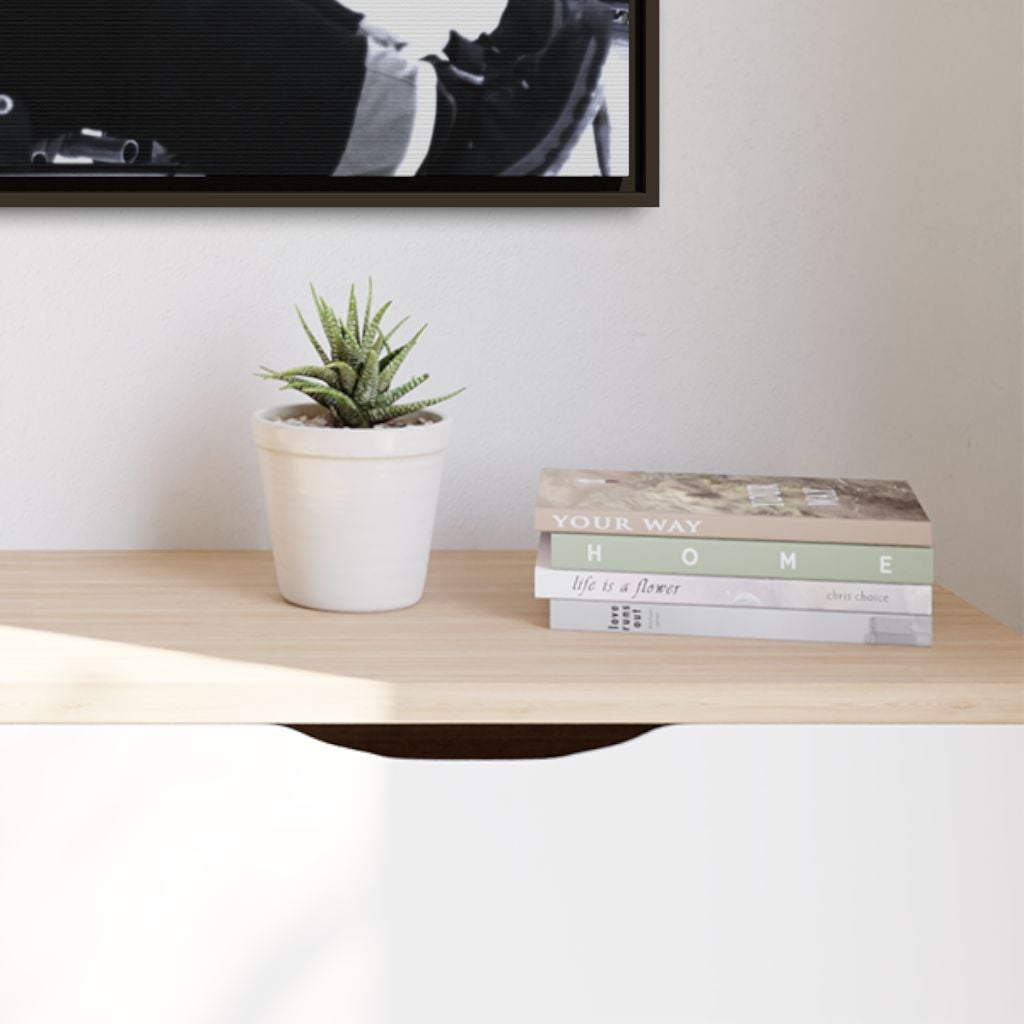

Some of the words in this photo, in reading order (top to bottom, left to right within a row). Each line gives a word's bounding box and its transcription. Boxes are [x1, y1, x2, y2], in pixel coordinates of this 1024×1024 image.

[552, 514, 632, 531] YOUR
[643, 517, 703, 533] WAY
[571, 575, 597, 597] life
[602, 579, 615, 592] is
[619, 583, 629, 593] a
[631, 577, 683, 599] flower
[826, 588, 852, 601] chris
[607, 605, 619, 630] love
[632, 608, 642, 629] out
